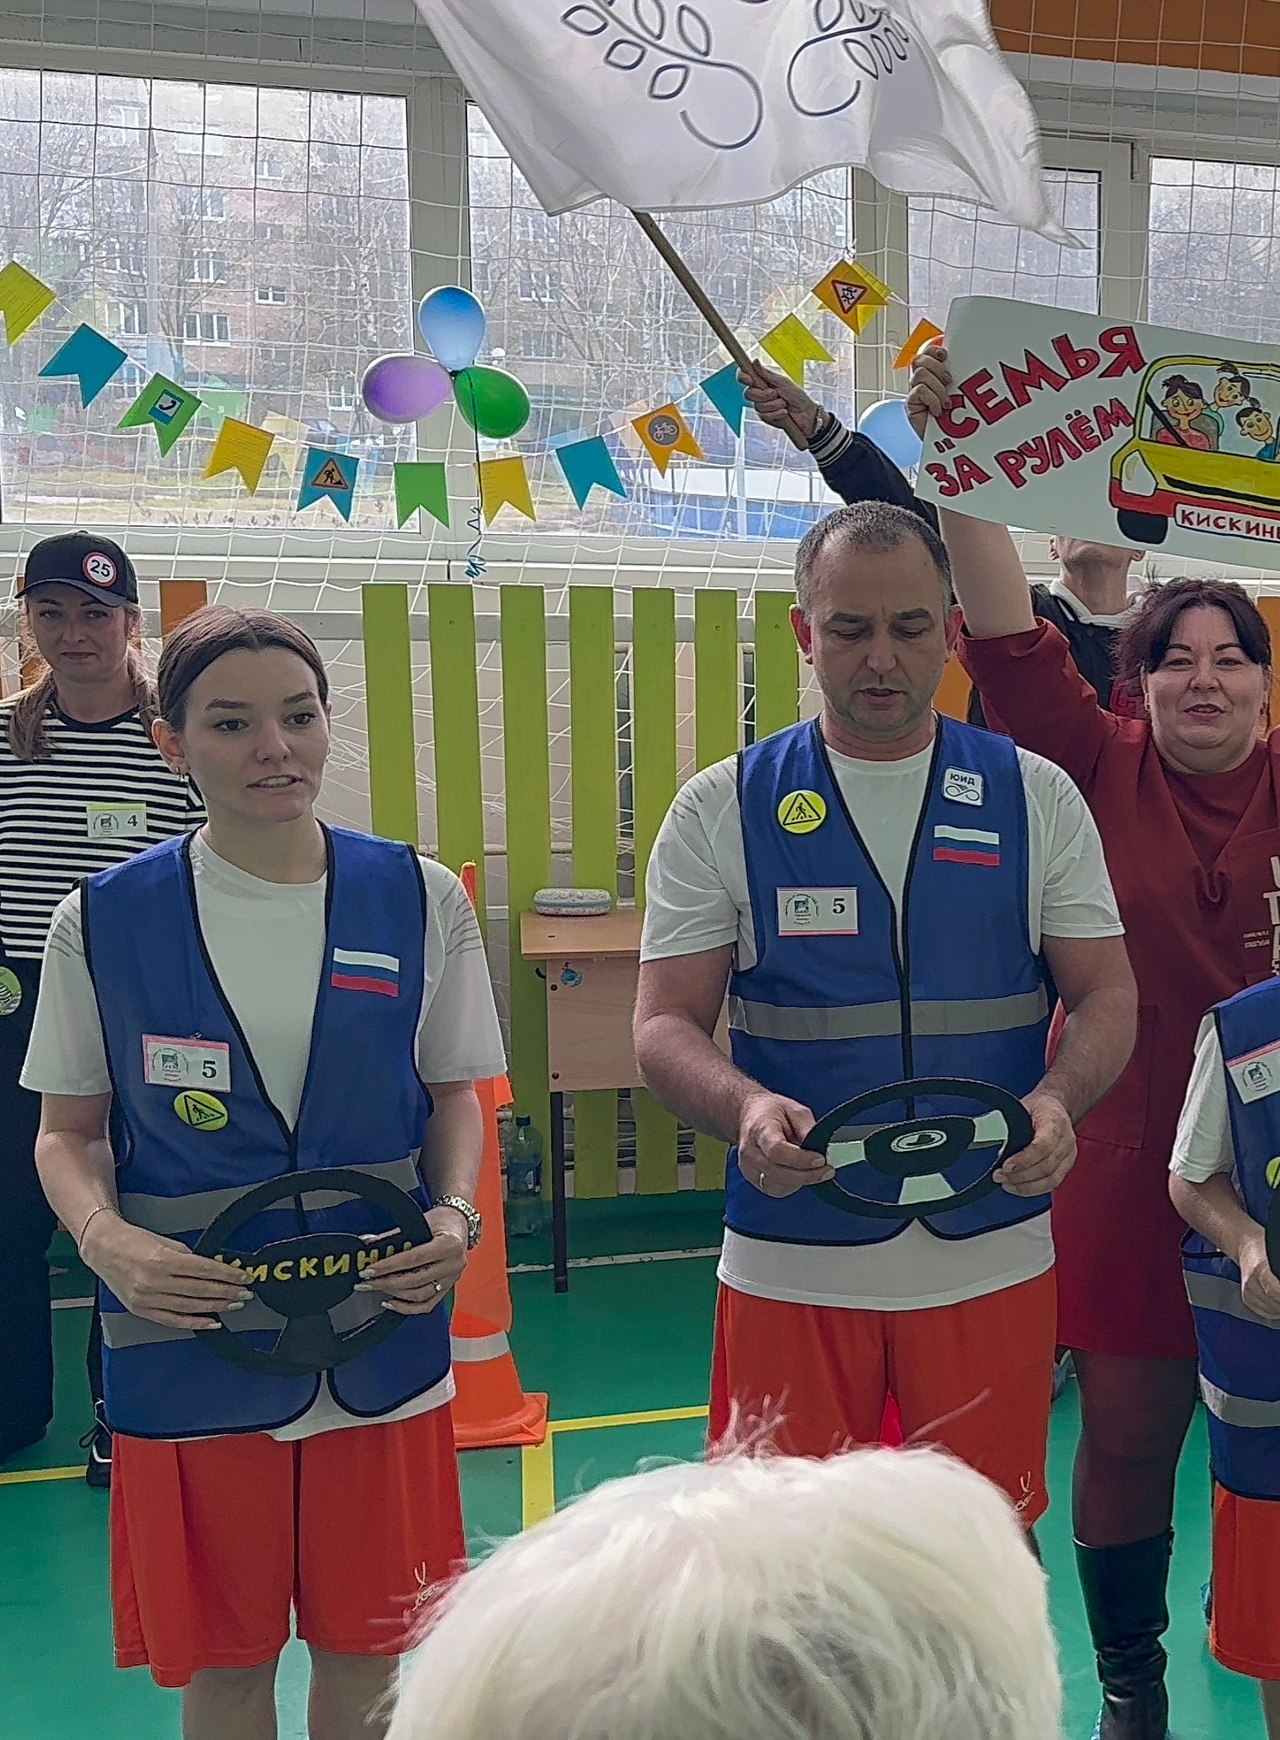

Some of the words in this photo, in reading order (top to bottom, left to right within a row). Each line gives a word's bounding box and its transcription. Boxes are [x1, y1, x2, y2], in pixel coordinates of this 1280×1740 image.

[925, 454, 993, 498] ЗА
[994, 398, 1135, 489] РУЛЁМ
[90, 559, 111, 577] 25
[950, 773, 976, 786] ЮИД
[127, 814, 139, 827] 4
[832, 897, 845, 914] 5
[202, 1060, 217, 1079] 5
